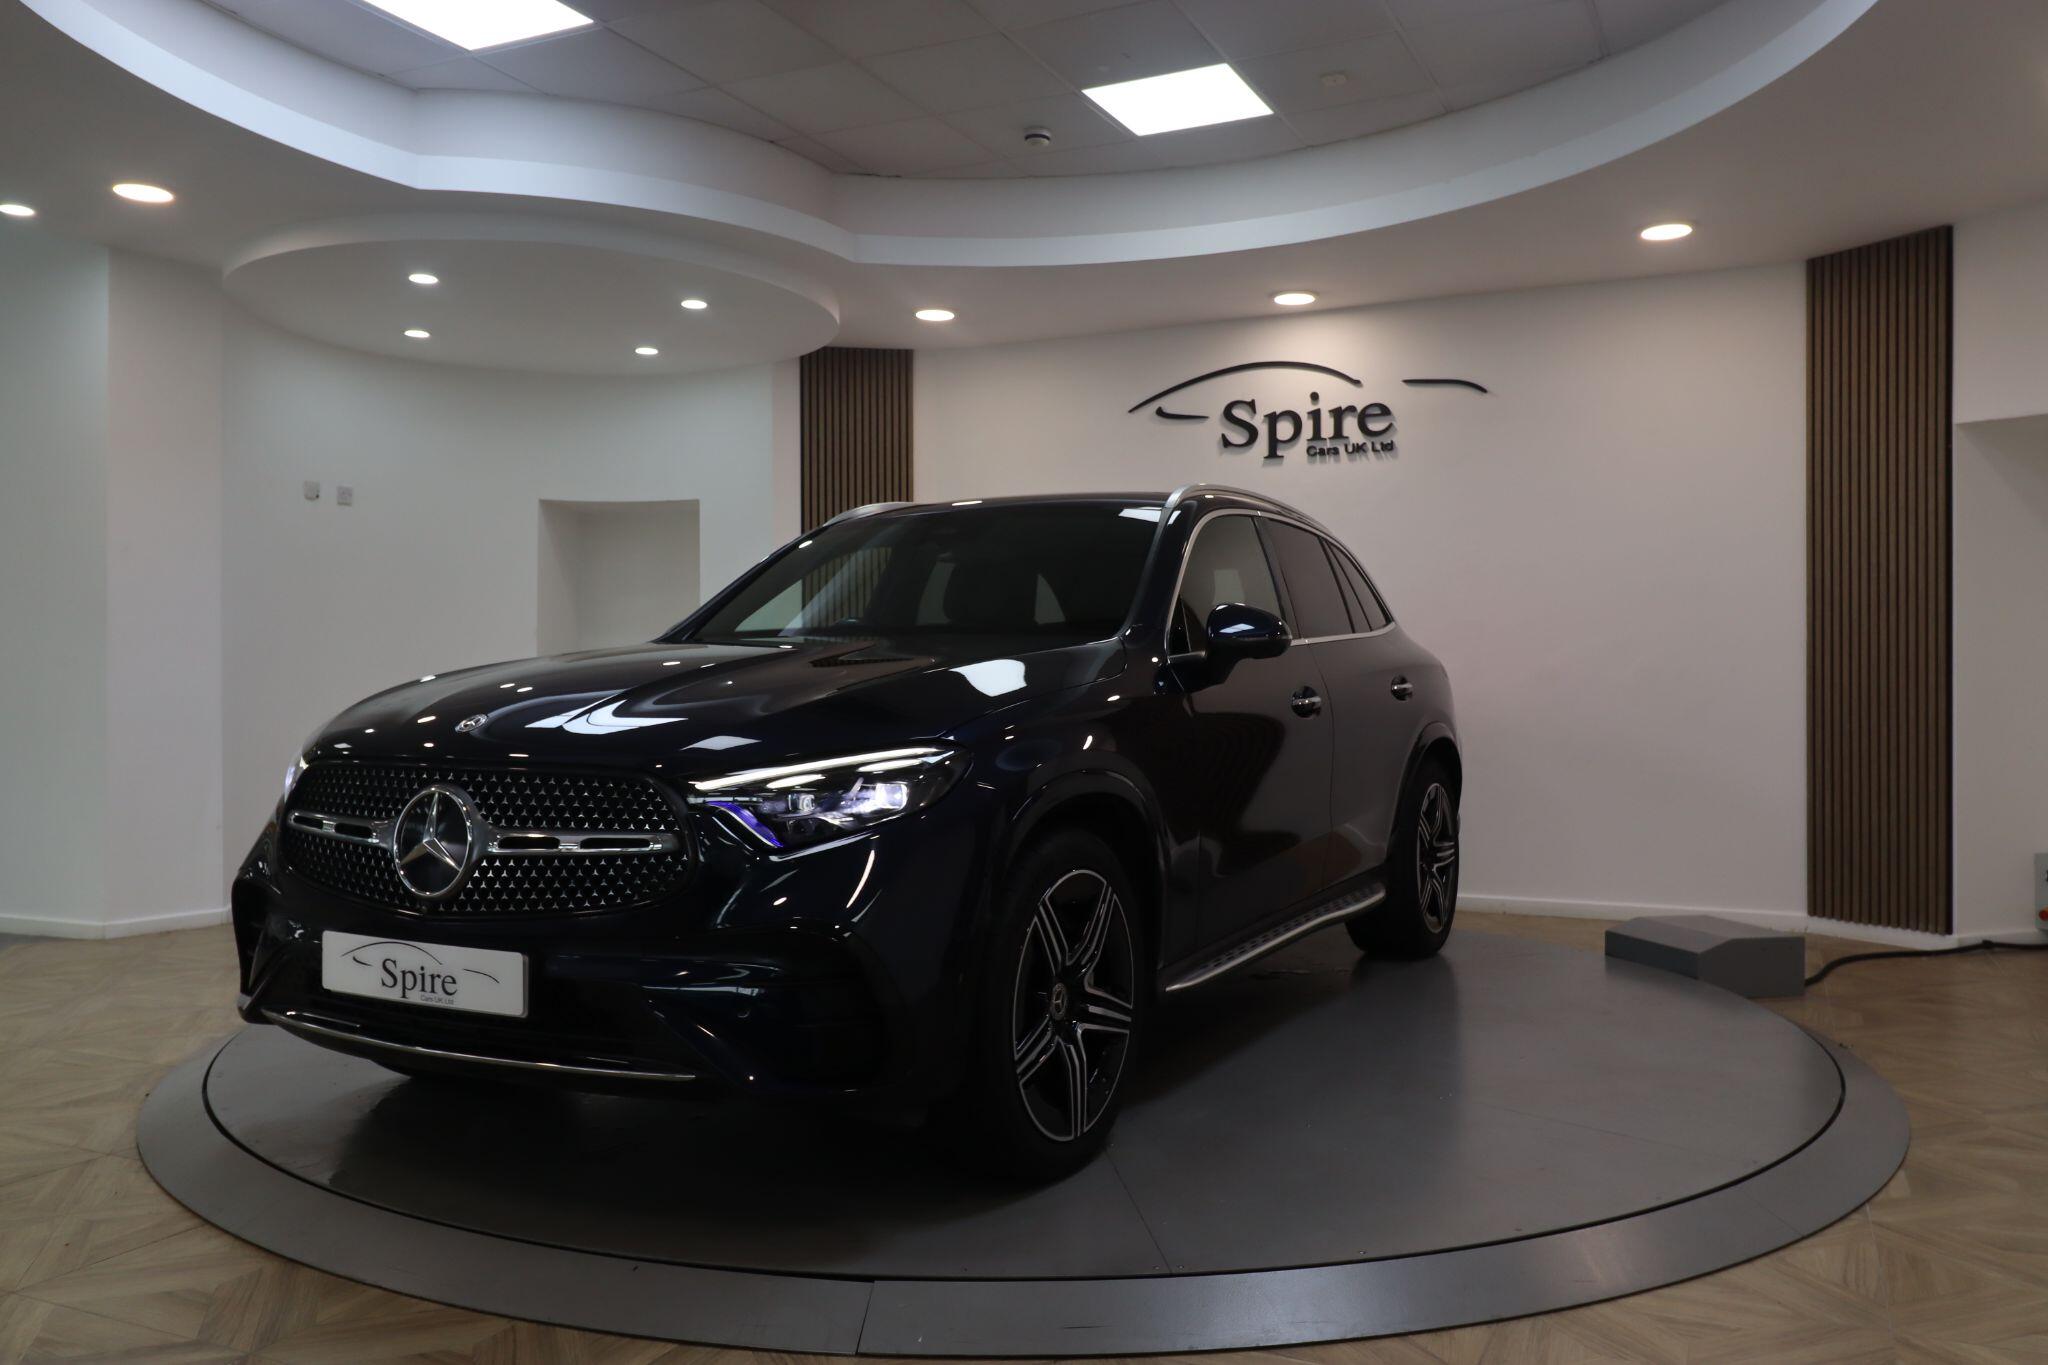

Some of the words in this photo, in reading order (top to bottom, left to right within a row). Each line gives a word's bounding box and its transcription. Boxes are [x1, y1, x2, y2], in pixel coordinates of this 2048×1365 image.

[1221, 391, 1394, 459] Spire
[1306, 445, 1340, 457] Cars
[1344, 442, 1367, 454] UK
[1371, 439, 1394, 452] Ltd
[381, 958, 458, 999] Spire
